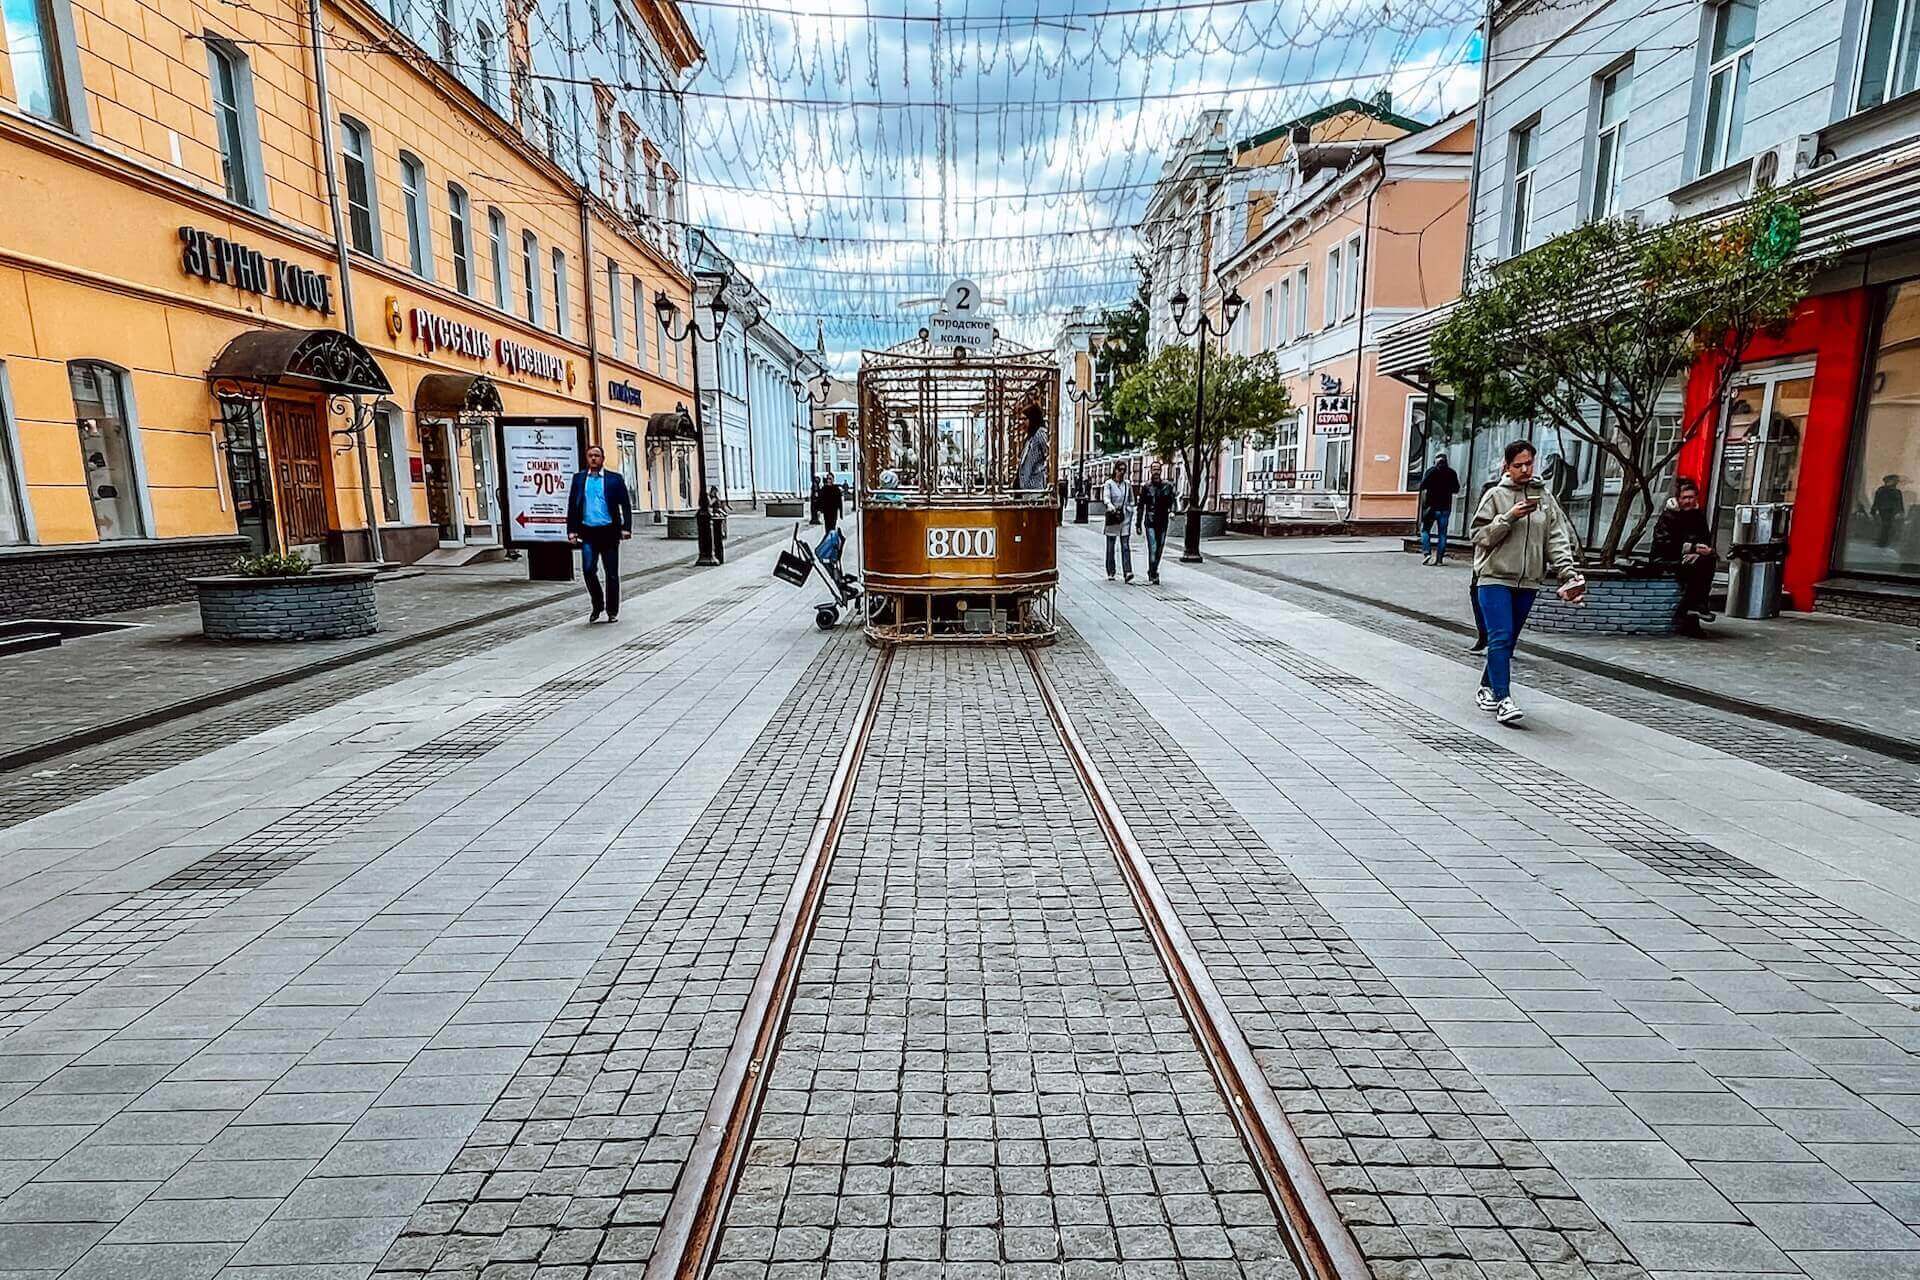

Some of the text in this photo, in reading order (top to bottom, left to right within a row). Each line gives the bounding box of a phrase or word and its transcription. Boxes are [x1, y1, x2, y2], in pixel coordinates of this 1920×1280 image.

[179, 226, 335, 315] ЗЕРНО КОФЕ
[956, 287, 970, 309] 2
[933, 319, 990, 330] городское
[413, 308, 564, 382] РУССКИЕ СУВЕНИРЫ
[940, 334, 981, 344] кольцо
[527, 461, 559, 471] СКИДКИ
[533, 473, 565, 494] 90%
[929, 528, 995, 557] 800
